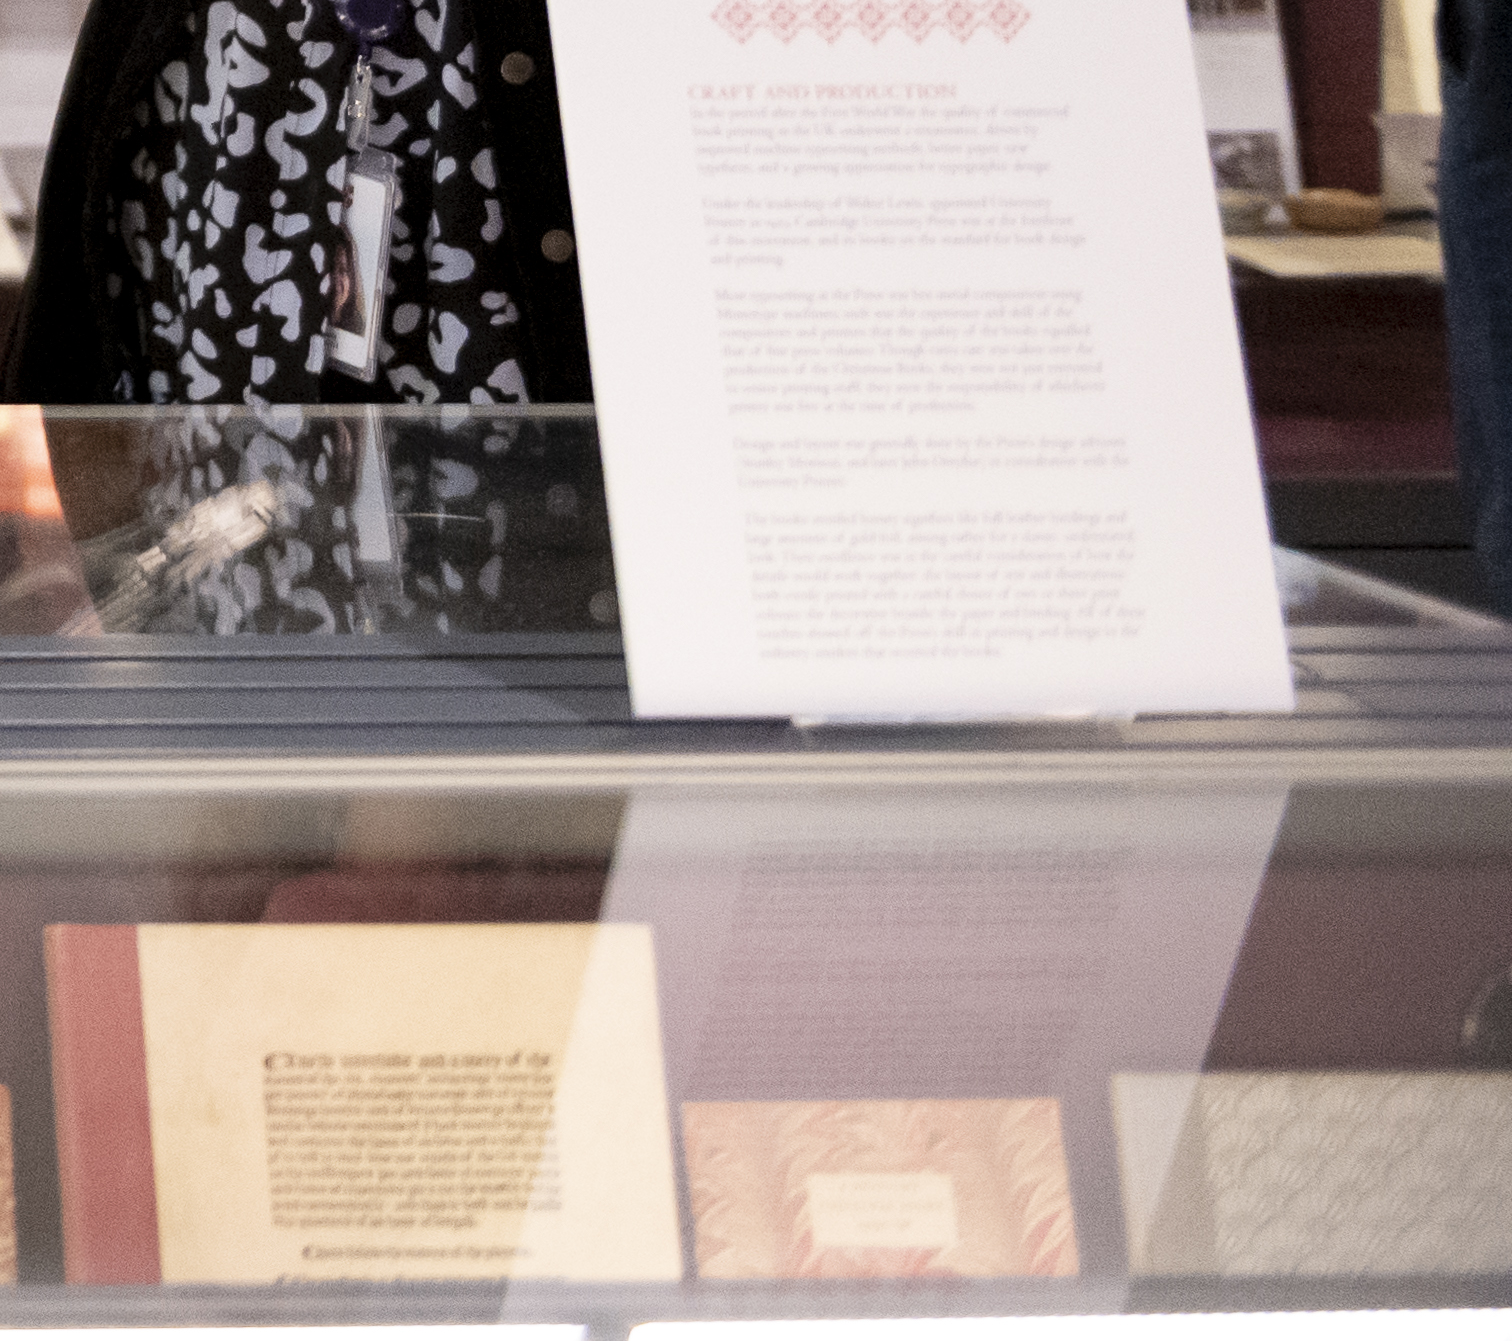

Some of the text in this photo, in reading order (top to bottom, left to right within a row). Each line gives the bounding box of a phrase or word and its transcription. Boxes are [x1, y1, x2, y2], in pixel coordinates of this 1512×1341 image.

[686, 83, 957, 100] CRAFT AND PRODUCTION
